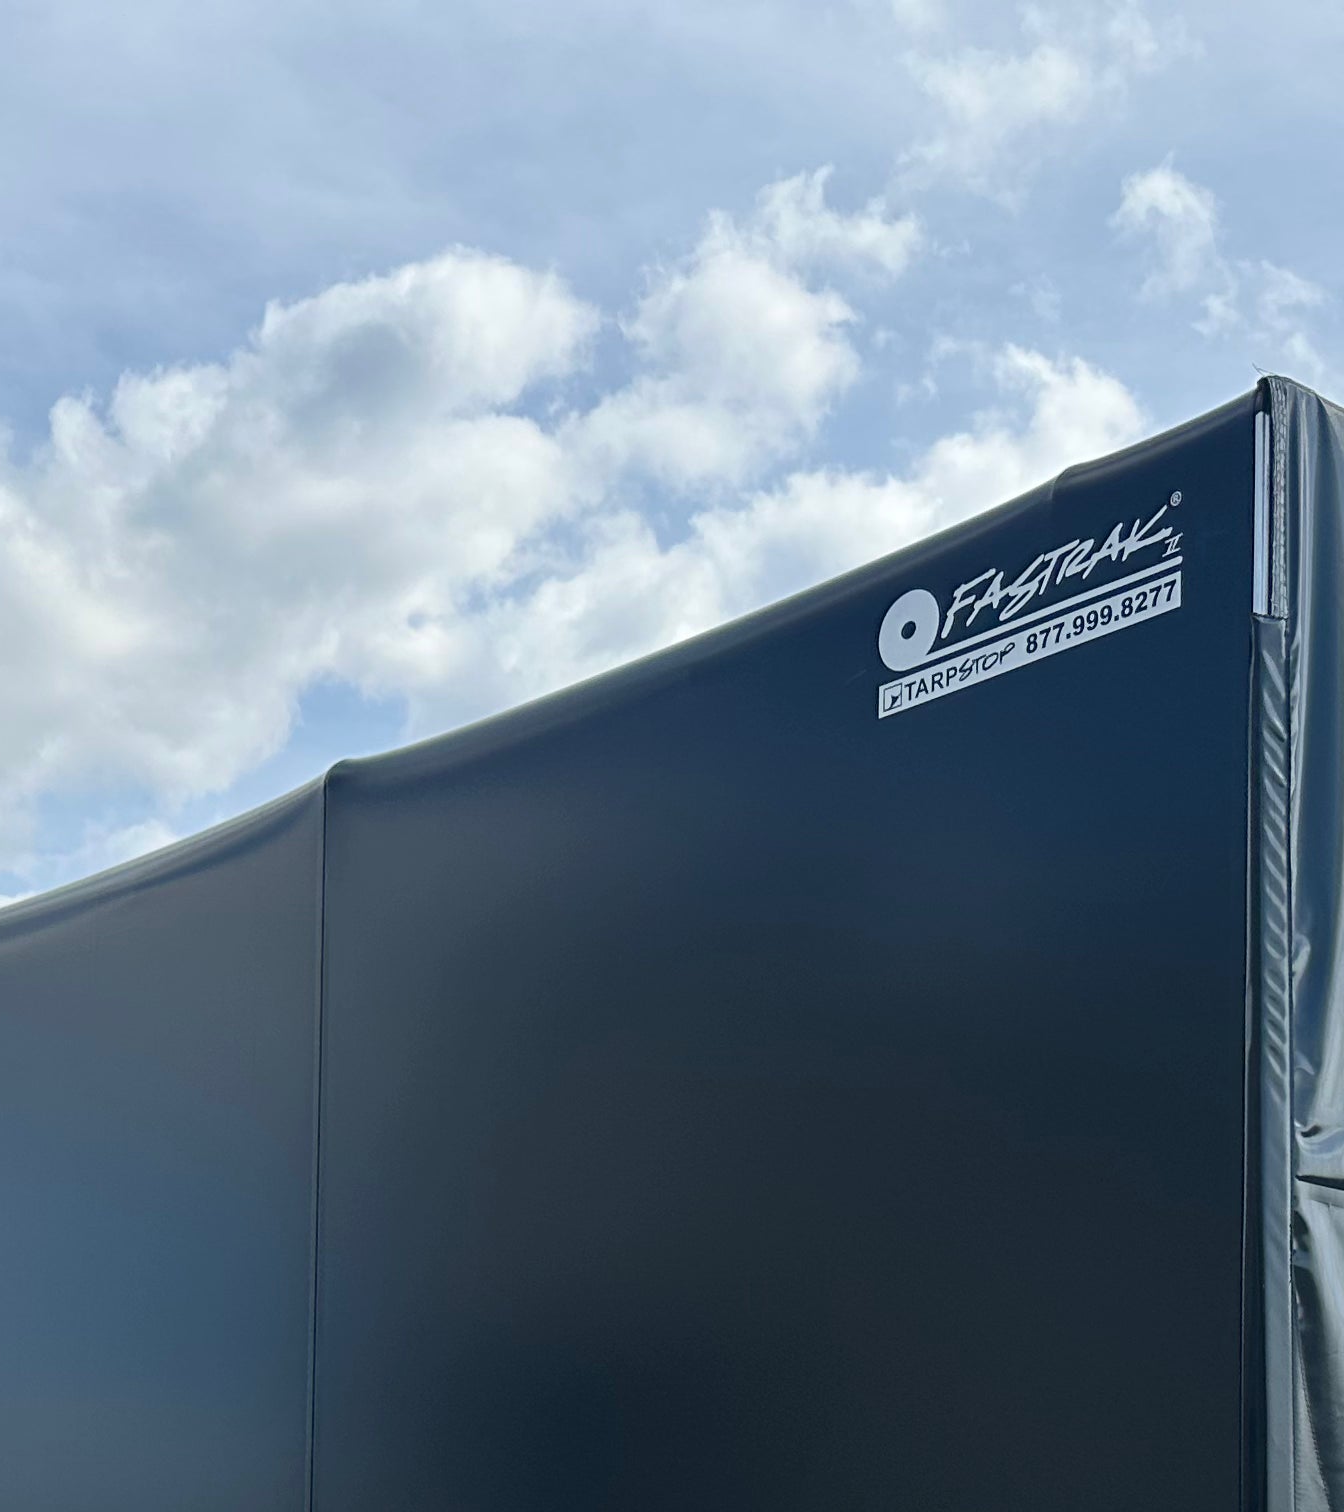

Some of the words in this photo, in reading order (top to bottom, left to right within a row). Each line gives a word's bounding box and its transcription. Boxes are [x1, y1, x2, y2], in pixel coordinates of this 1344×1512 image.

[941, 505, 1173, 639] FASTRAK
[904, 643, 1015, 701] TARPSTOP
[1026, 580, 1177, 654] 877.999.8277
